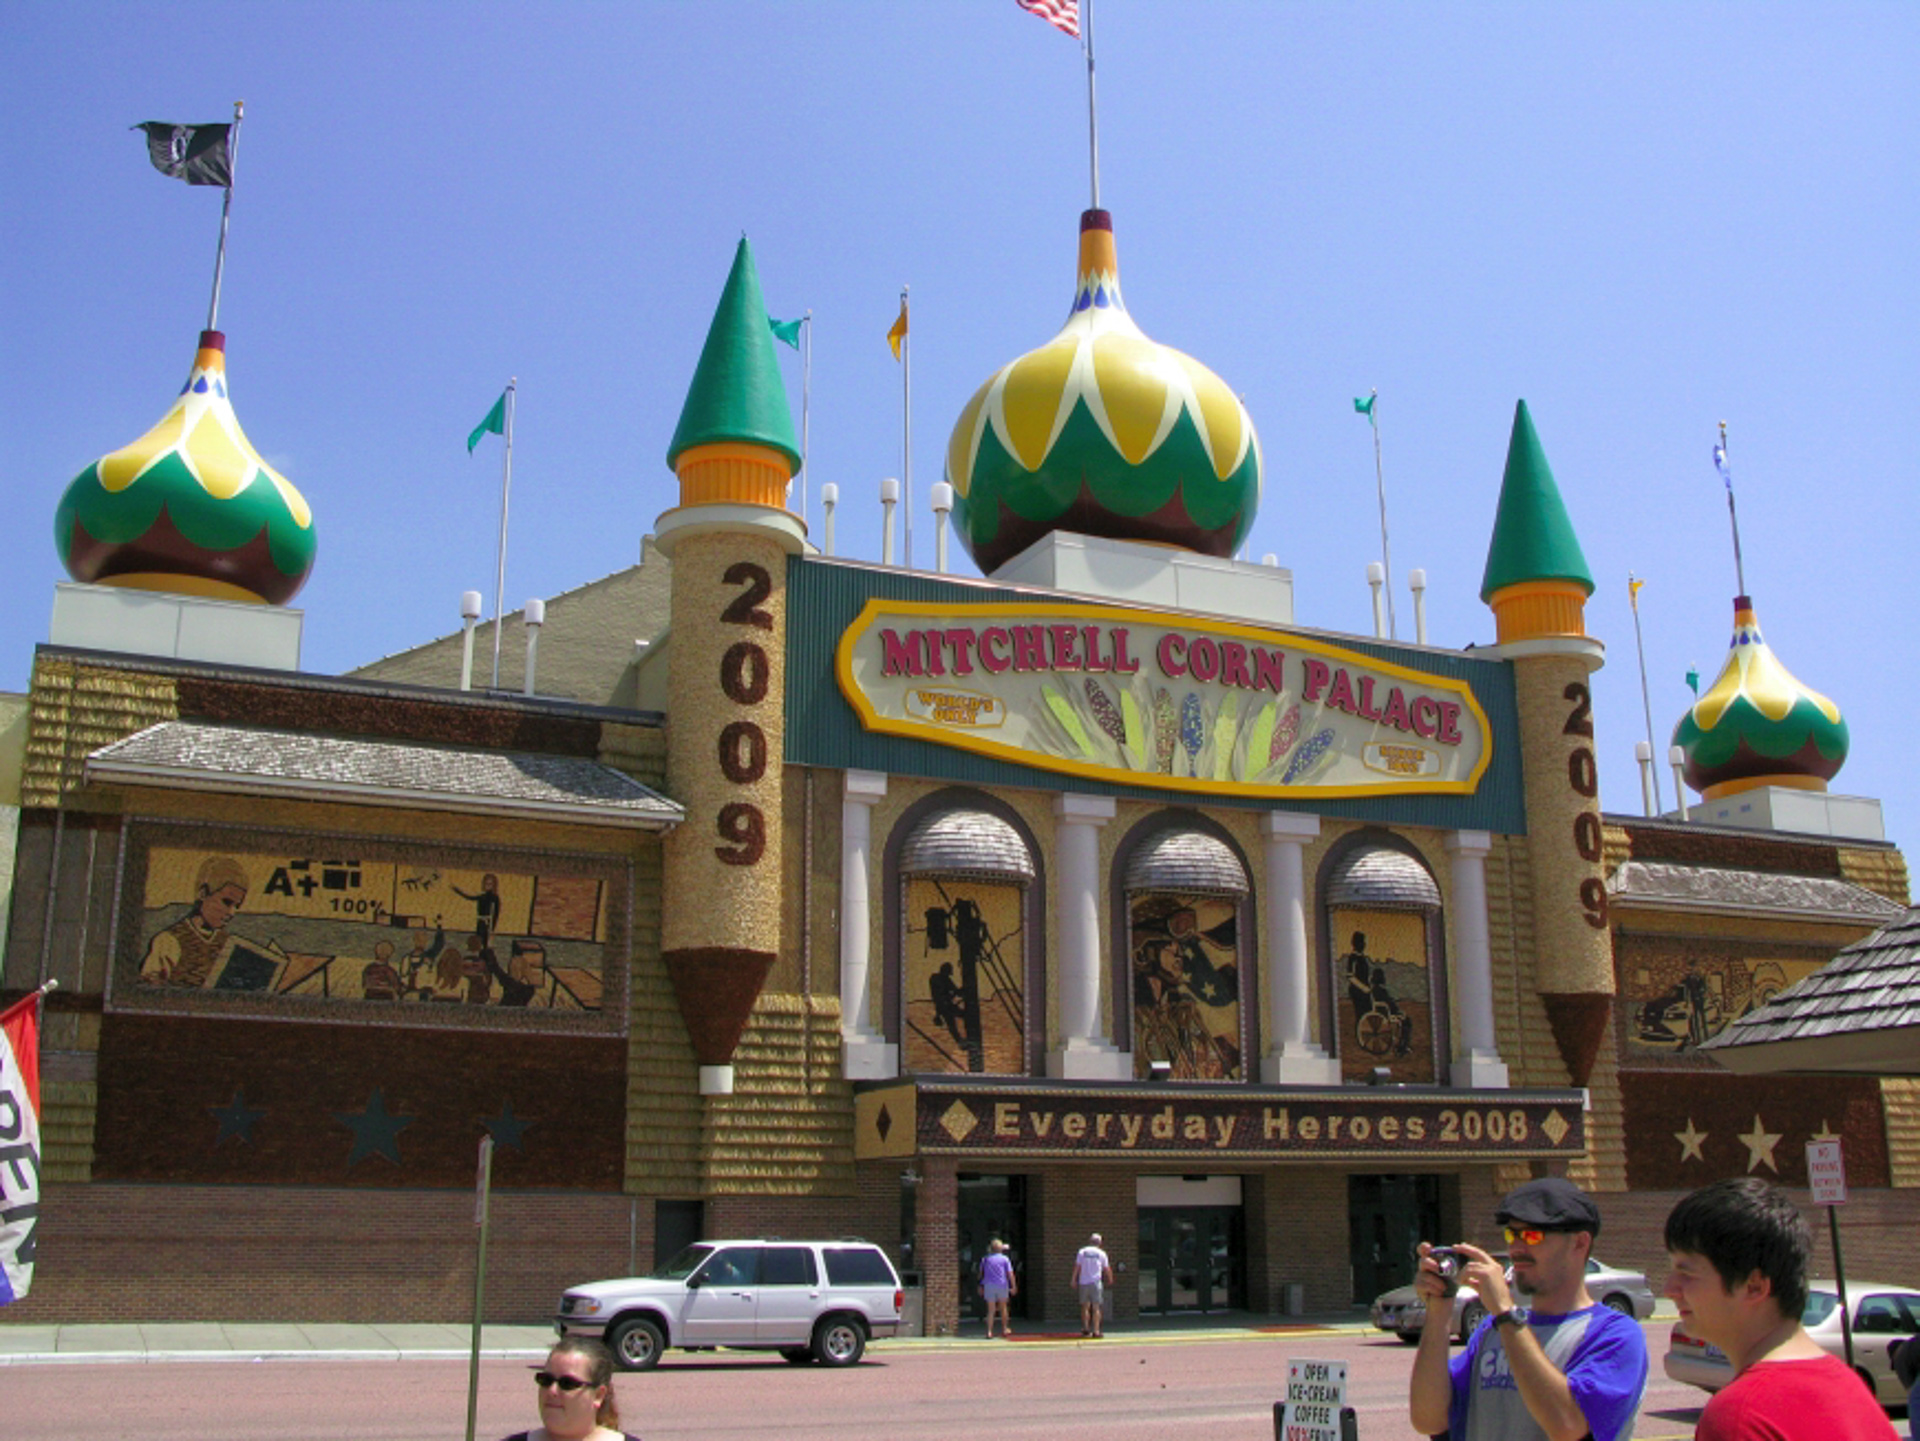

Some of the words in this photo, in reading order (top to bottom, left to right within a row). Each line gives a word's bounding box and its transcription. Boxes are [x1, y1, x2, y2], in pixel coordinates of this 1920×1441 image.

[879, 623, 1140, 678] MITCHELL
[1156, 632, 1285, 694] CORN
[1302, 657, 1462, 746] PALACE
[715, 561, 774, 866] 2009
[1562, 682, 1608, 930] 2009
[263, 866, 319, 897] A+
[330, 897, 388, 915] 100%
[994, 1102, 1237, 1148] Everyday
[1263, 1107, 1426, 1141] Heroes
[1438, 1110, 1529, 1142] 2008
[1304, 1363, 1329, 1381] OPEN
[1288, 1383, 1340, 1402] ICE-CREAM
[1295, 1405, 1330, 1424] COFFEE
